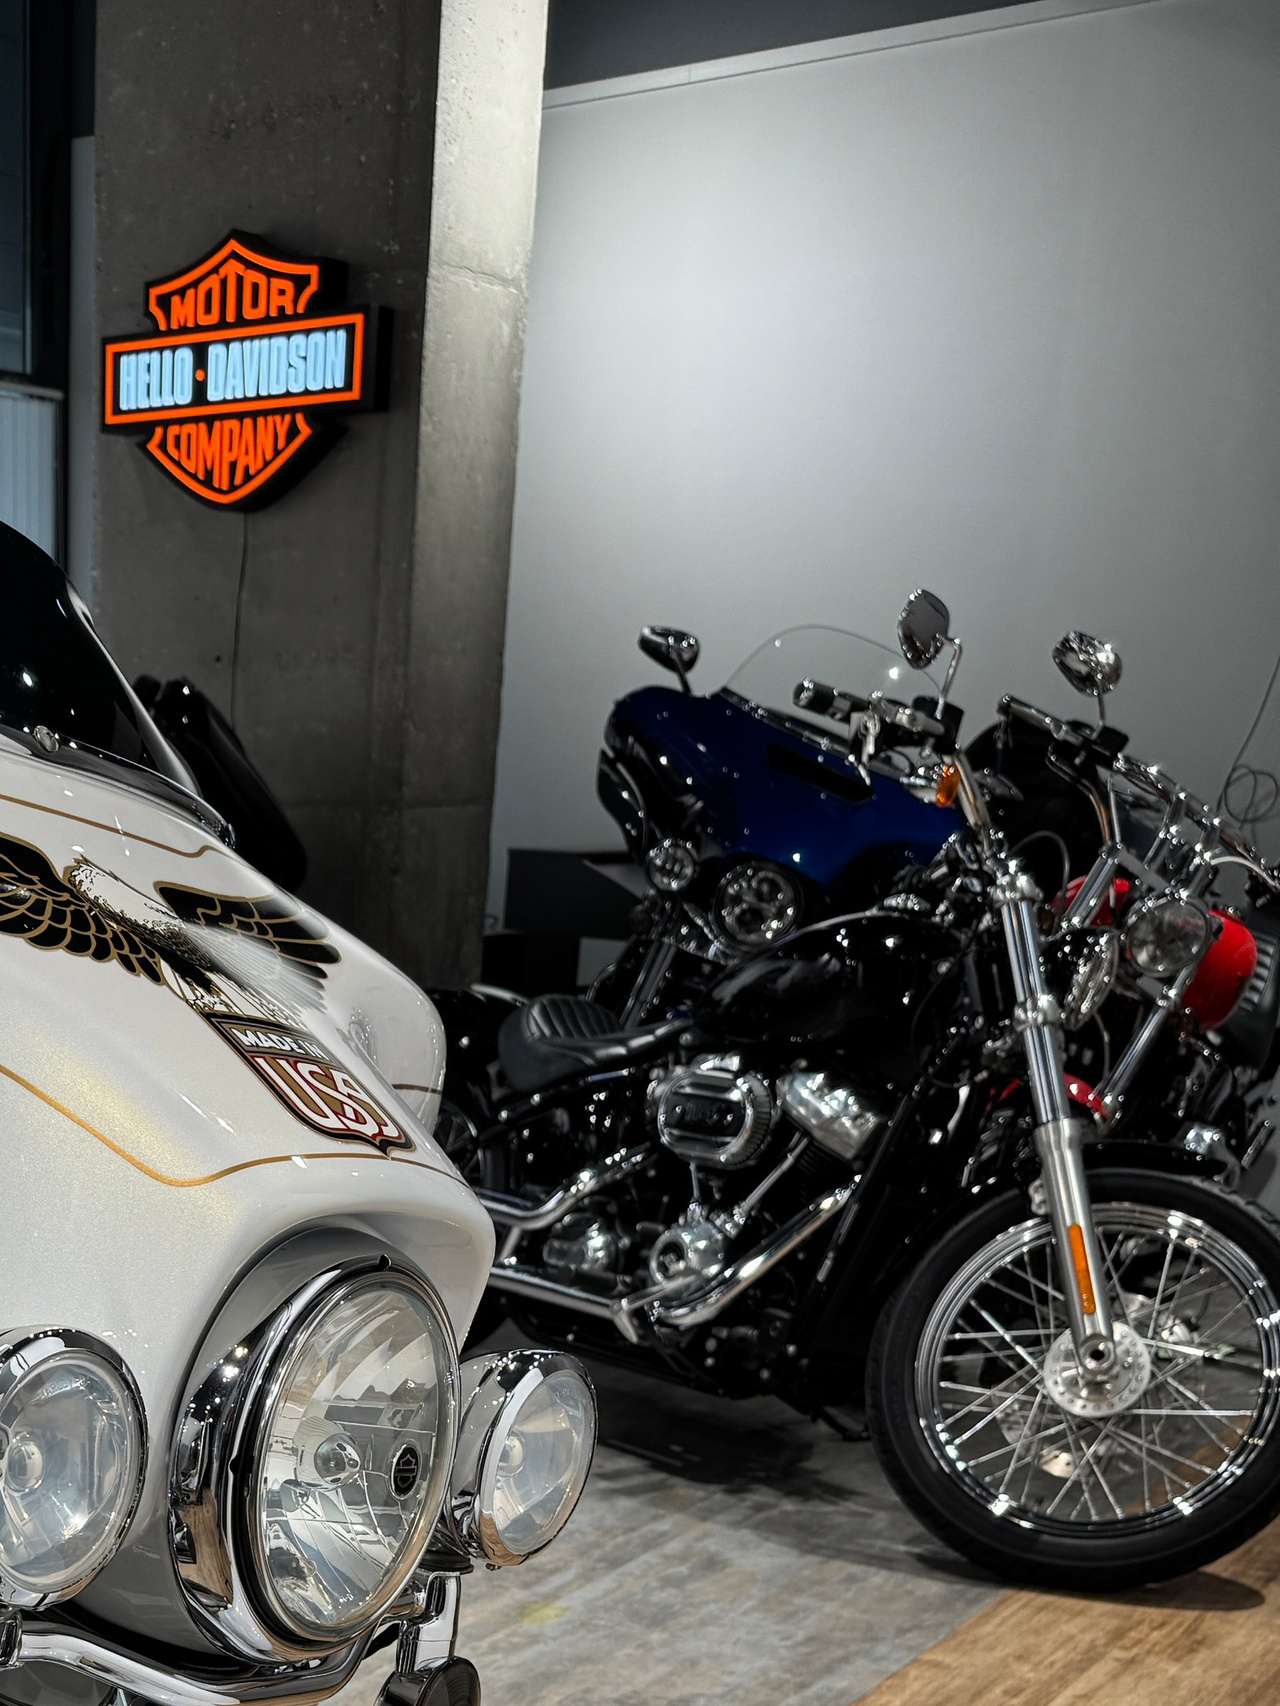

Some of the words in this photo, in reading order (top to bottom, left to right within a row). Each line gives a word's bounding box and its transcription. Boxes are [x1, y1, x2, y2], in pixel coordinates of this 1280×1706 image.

[170, 258, 295, 330] MOTOR
[207, 329, 347, 402] DAVIDSON
[167, 413, 292, 491] COMPANY
[231, 1027, 306, 1055] MADE
[302, 1039, 330, 1061] IN
[253, 1056, 400, 1138] USA
